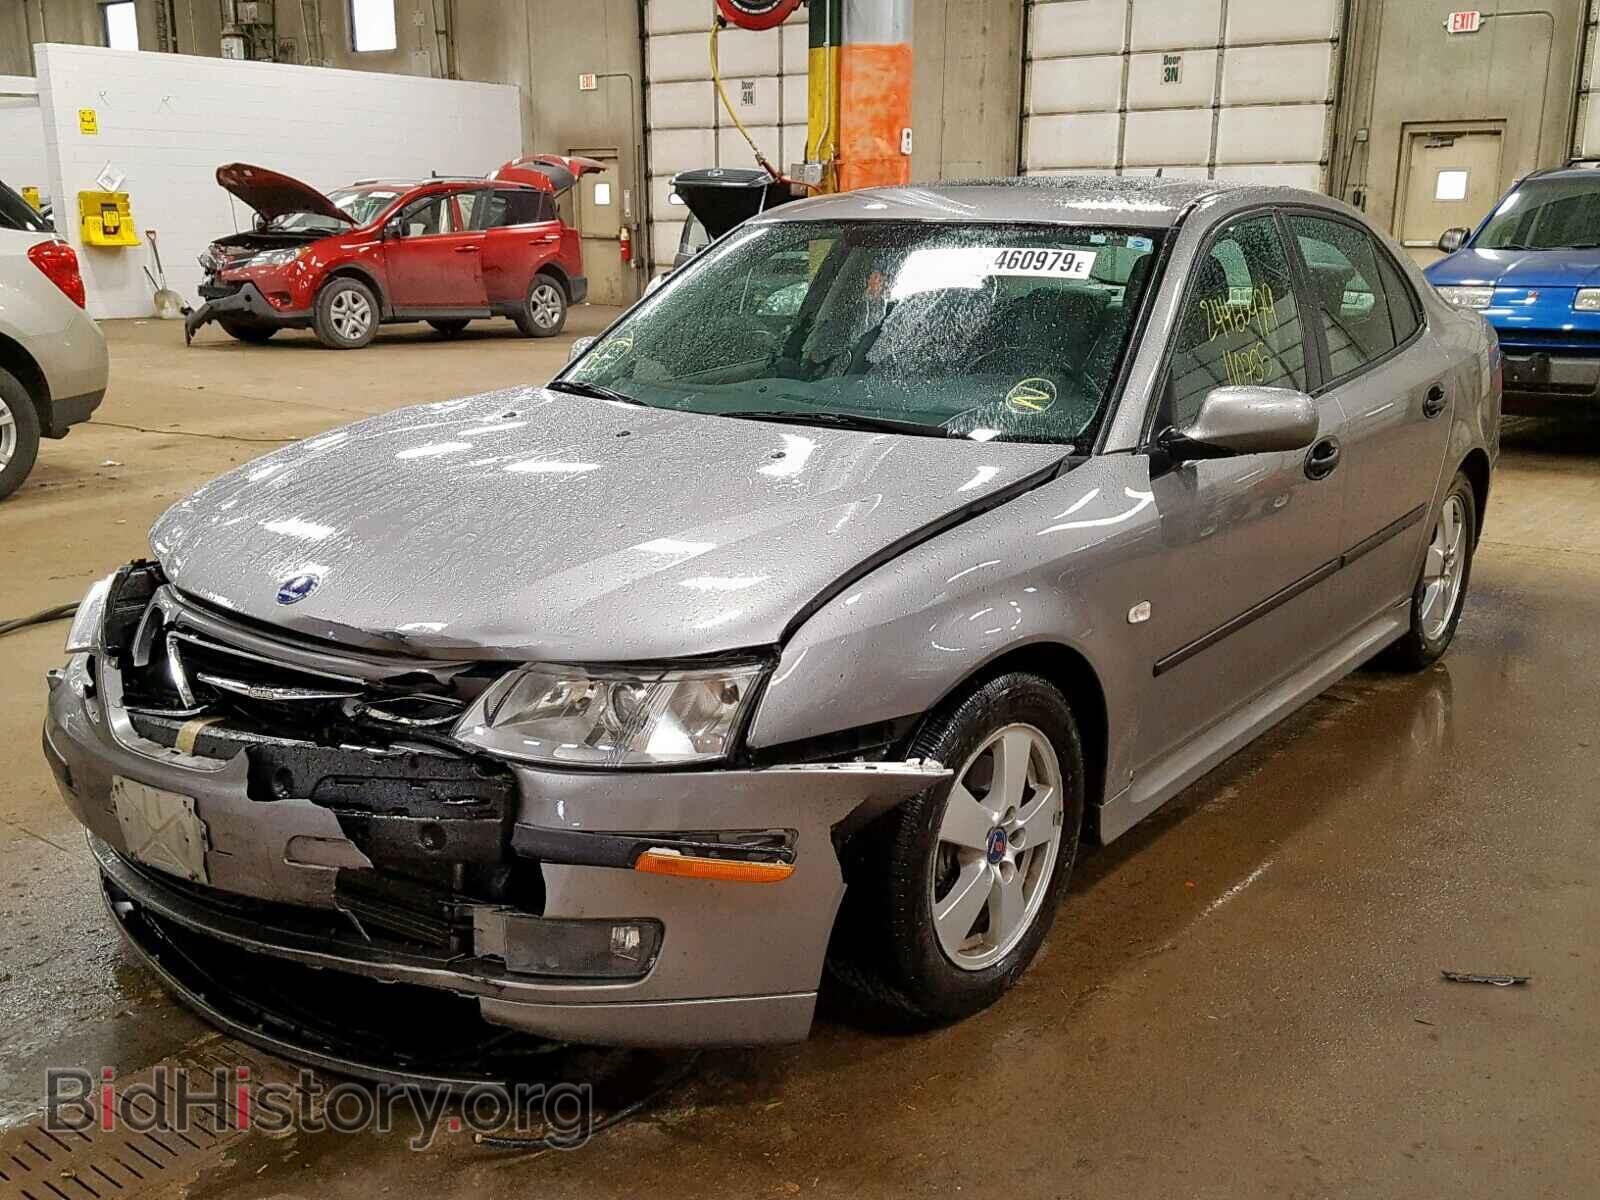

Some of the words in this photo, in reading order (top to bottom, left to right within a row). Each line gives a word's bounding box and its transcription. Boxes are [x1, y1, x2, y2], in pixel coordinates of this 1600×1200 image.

[1454, 12, 1477, 30] EXIT
[1163, 55, 1181, 65] Door
[1164, 67, 1179, 82] 3N
[741, 80, 754, 89] Door
[743, 91, 754, 105] 4N
